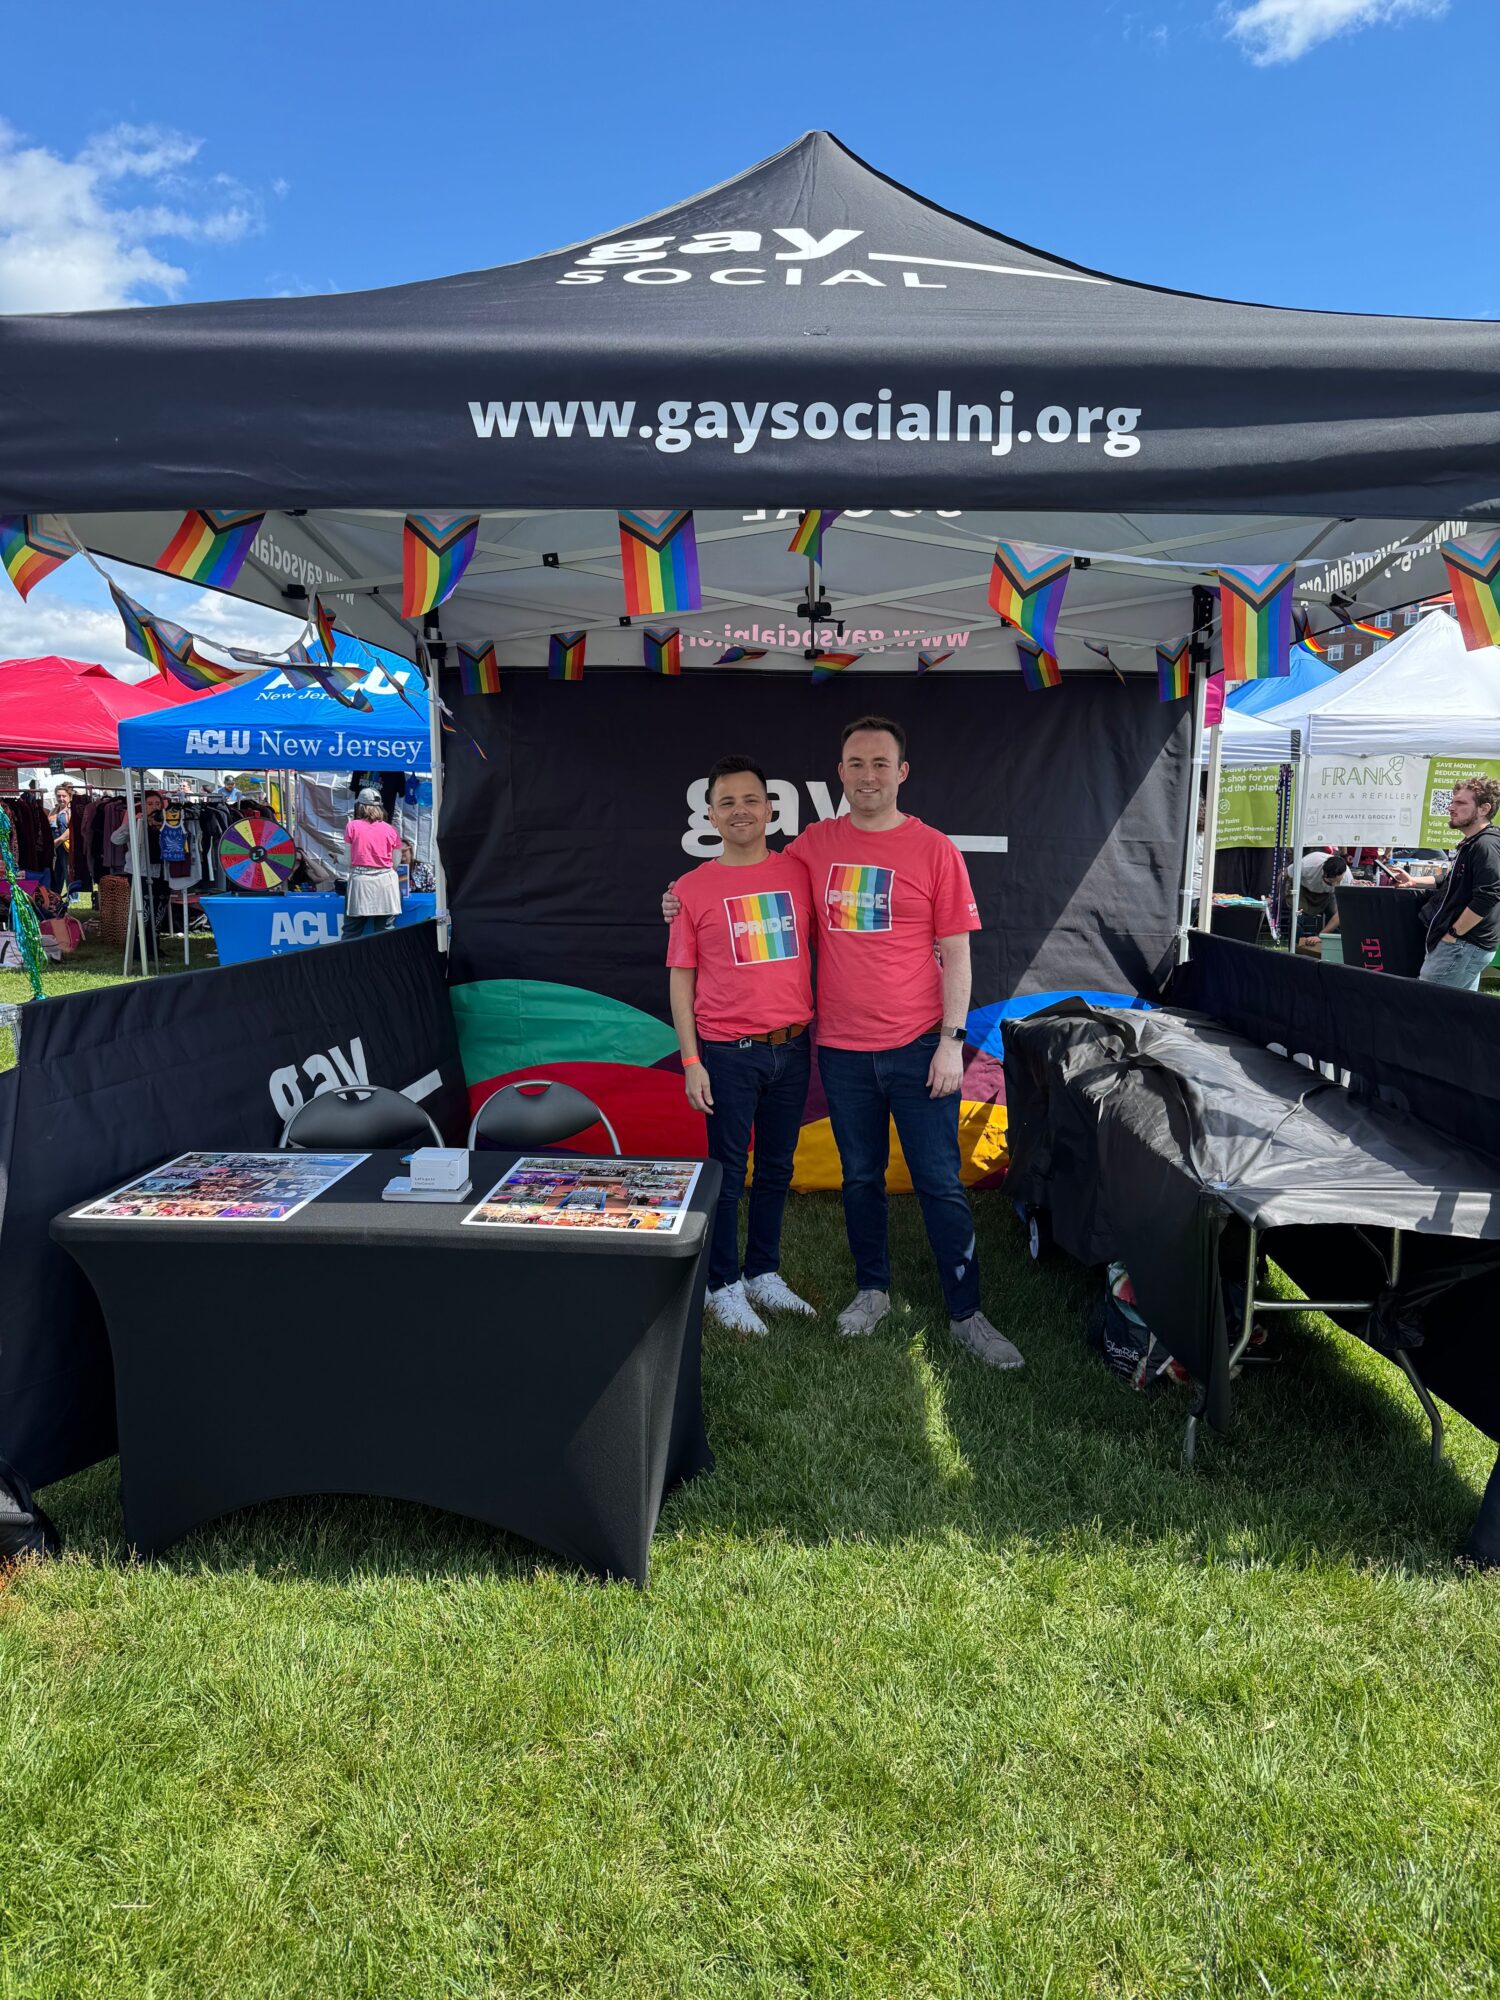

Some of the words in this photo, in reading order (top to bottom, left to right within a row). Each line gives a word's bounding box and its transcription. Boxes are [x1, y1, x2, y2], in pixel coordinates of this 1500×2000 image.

[574, 228, 865, 265] gay
[555, 268, 948, 288] SOCIAL
[467, 389, 1142, 457] www.gaysocialnj.org
[255, 691, 296, 701] New
[185, 729, 251, 755] ACLU
[258, 730, 322, 756] New
[328, 731, 424, 764] Jersey
[1227, 774, 1247, 783] shop
[1248, 773, 1262, 781] for
[1263, 775, 1280, 783] you
[1362, 792, 1419, 800] REFILLERY
[828, 889, 888, 910] PRIDE
[734, 914, 793, 938] PRIDE
